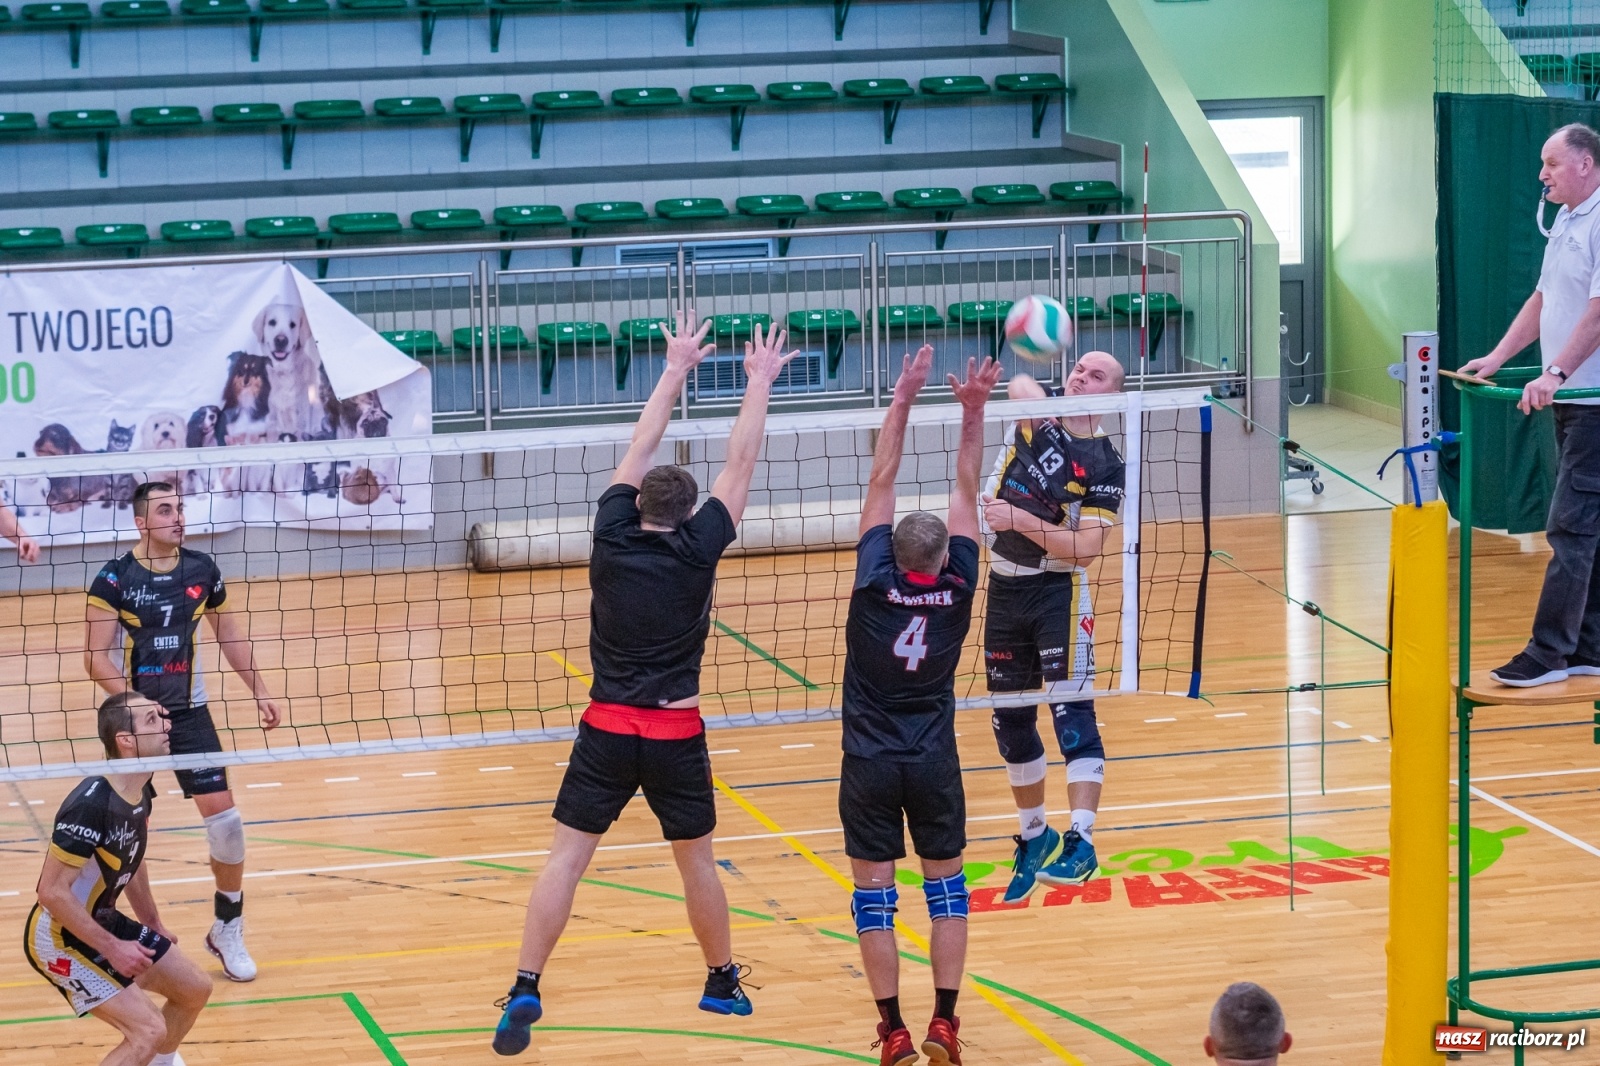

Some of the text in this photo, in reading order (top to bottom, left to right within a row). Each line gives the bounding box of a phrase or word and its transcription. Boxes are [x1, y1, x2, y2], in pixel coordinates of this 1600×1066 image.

[8, 306, 173, 353] TWOJEGO
[1421, 405, 1430, 462] spot
[1038, 446, 1064, 476] 13
[161, 605, 173, 627] 7
[154, 635, 179, 647] ENTER
[893, 616, 927, 670] 4
[128, 841, 140, 864] 4
[69, 979, 92, 997] 4
